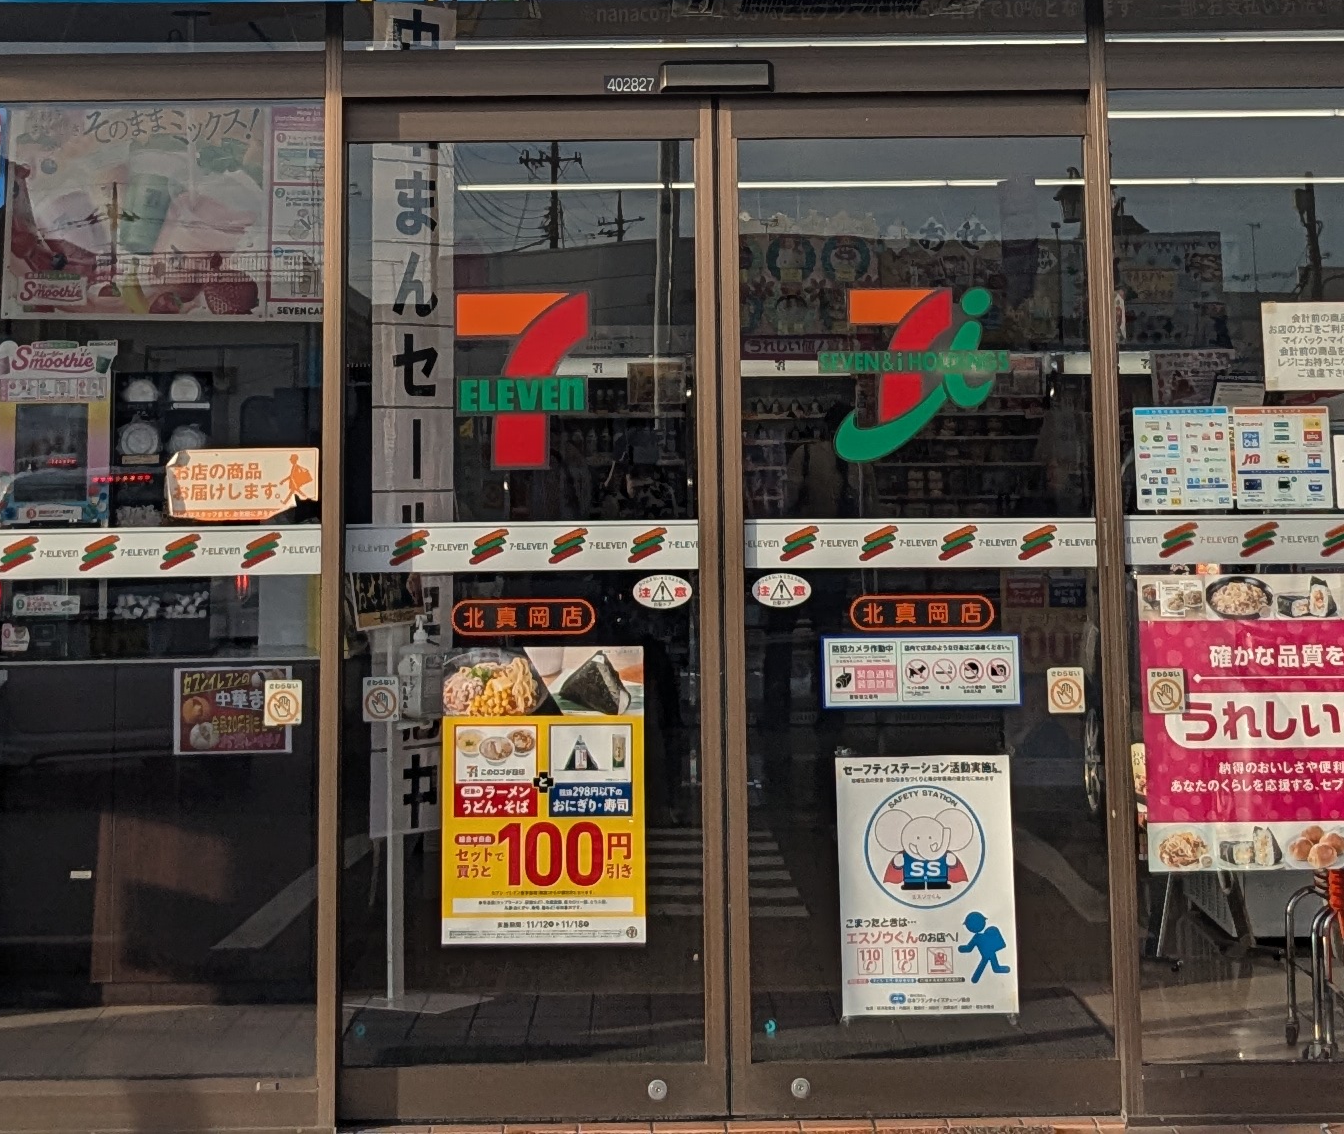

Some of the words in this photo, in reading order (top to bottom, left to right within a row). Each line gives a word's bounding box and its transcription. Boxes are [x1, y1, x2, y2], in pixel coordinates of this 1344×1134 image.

[607, 77, 655, 94] 402827
[11, 344, 94, 371] Smoothie
[173, 462, 262, 481] お店の商品
[172, 482, 281, 501] お届けします。
[464, 606, 584, 629] 北真岡店
[862, 603, 982, 624] 北真岡店
[485, 785, 531, 798] ラーメン
[887, 790, 919, 808] SAFETY
[922, 789, 959, 808] STATION
[463, 799, 530, 814] うどん・そば
[553, 798, 629, 813] おにぎり・寿司
[455, 848, 504, 862] セットで
[498, 821, 604, 887] 100
[456, 864, 492, 879] 買うと
[606, 863, 632, 880] 引き
[909, 861, 942, 877] SS
[846, 931, 959, 945] エスゾウくんのお店へ!
[859, 949, 881, 961] 110
[894, 949, 916, 961] 119
